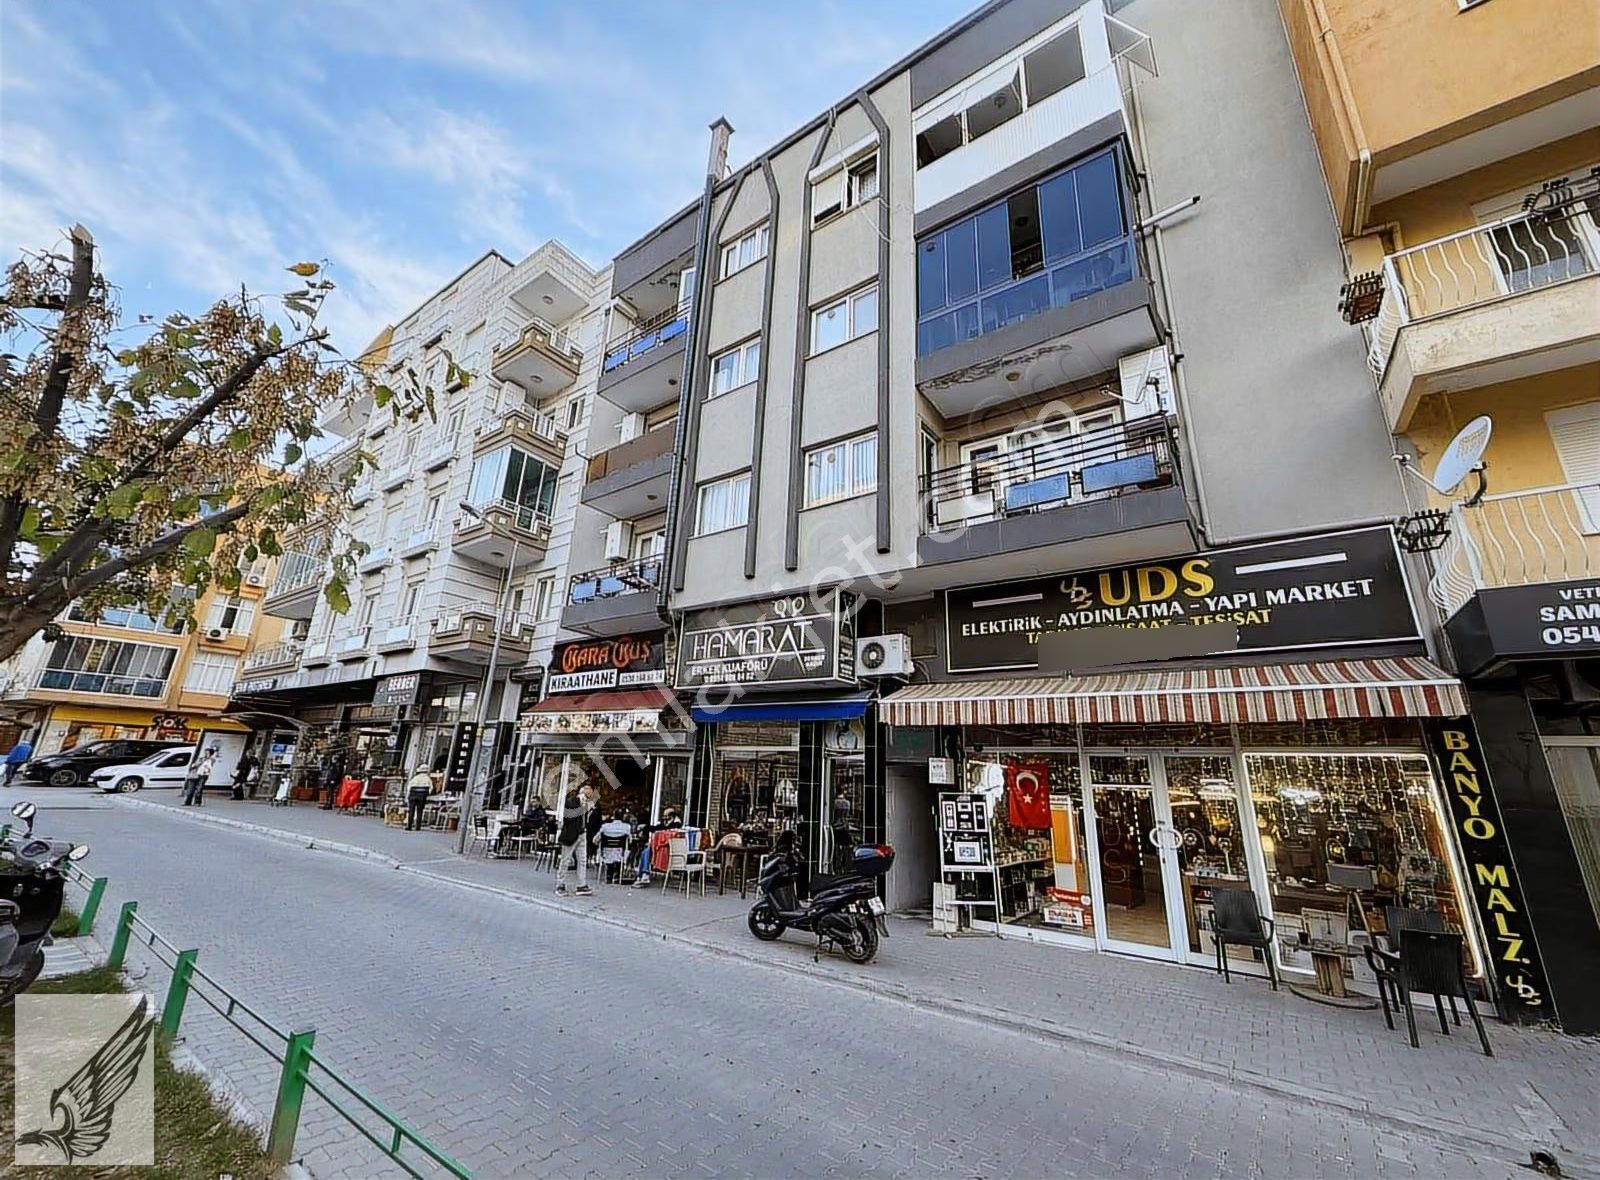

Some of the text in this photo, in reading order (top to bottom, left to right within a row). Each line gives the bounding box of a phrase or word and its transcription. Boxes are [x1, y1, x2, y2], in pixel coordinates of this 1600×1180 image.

[1058, 602, 1184, 627] AYDINLATMA
[1204, 594, 1256, 612] YAPI
[1266, 579, 1374, 607] MARKET
[1100, 560, 1214, 607] UDS
[693, 621, 813, 676] HAMARAT
[551, 671, 615, 690] KIRAATHANE
[1443, 731, 1495, 840] BANYO
